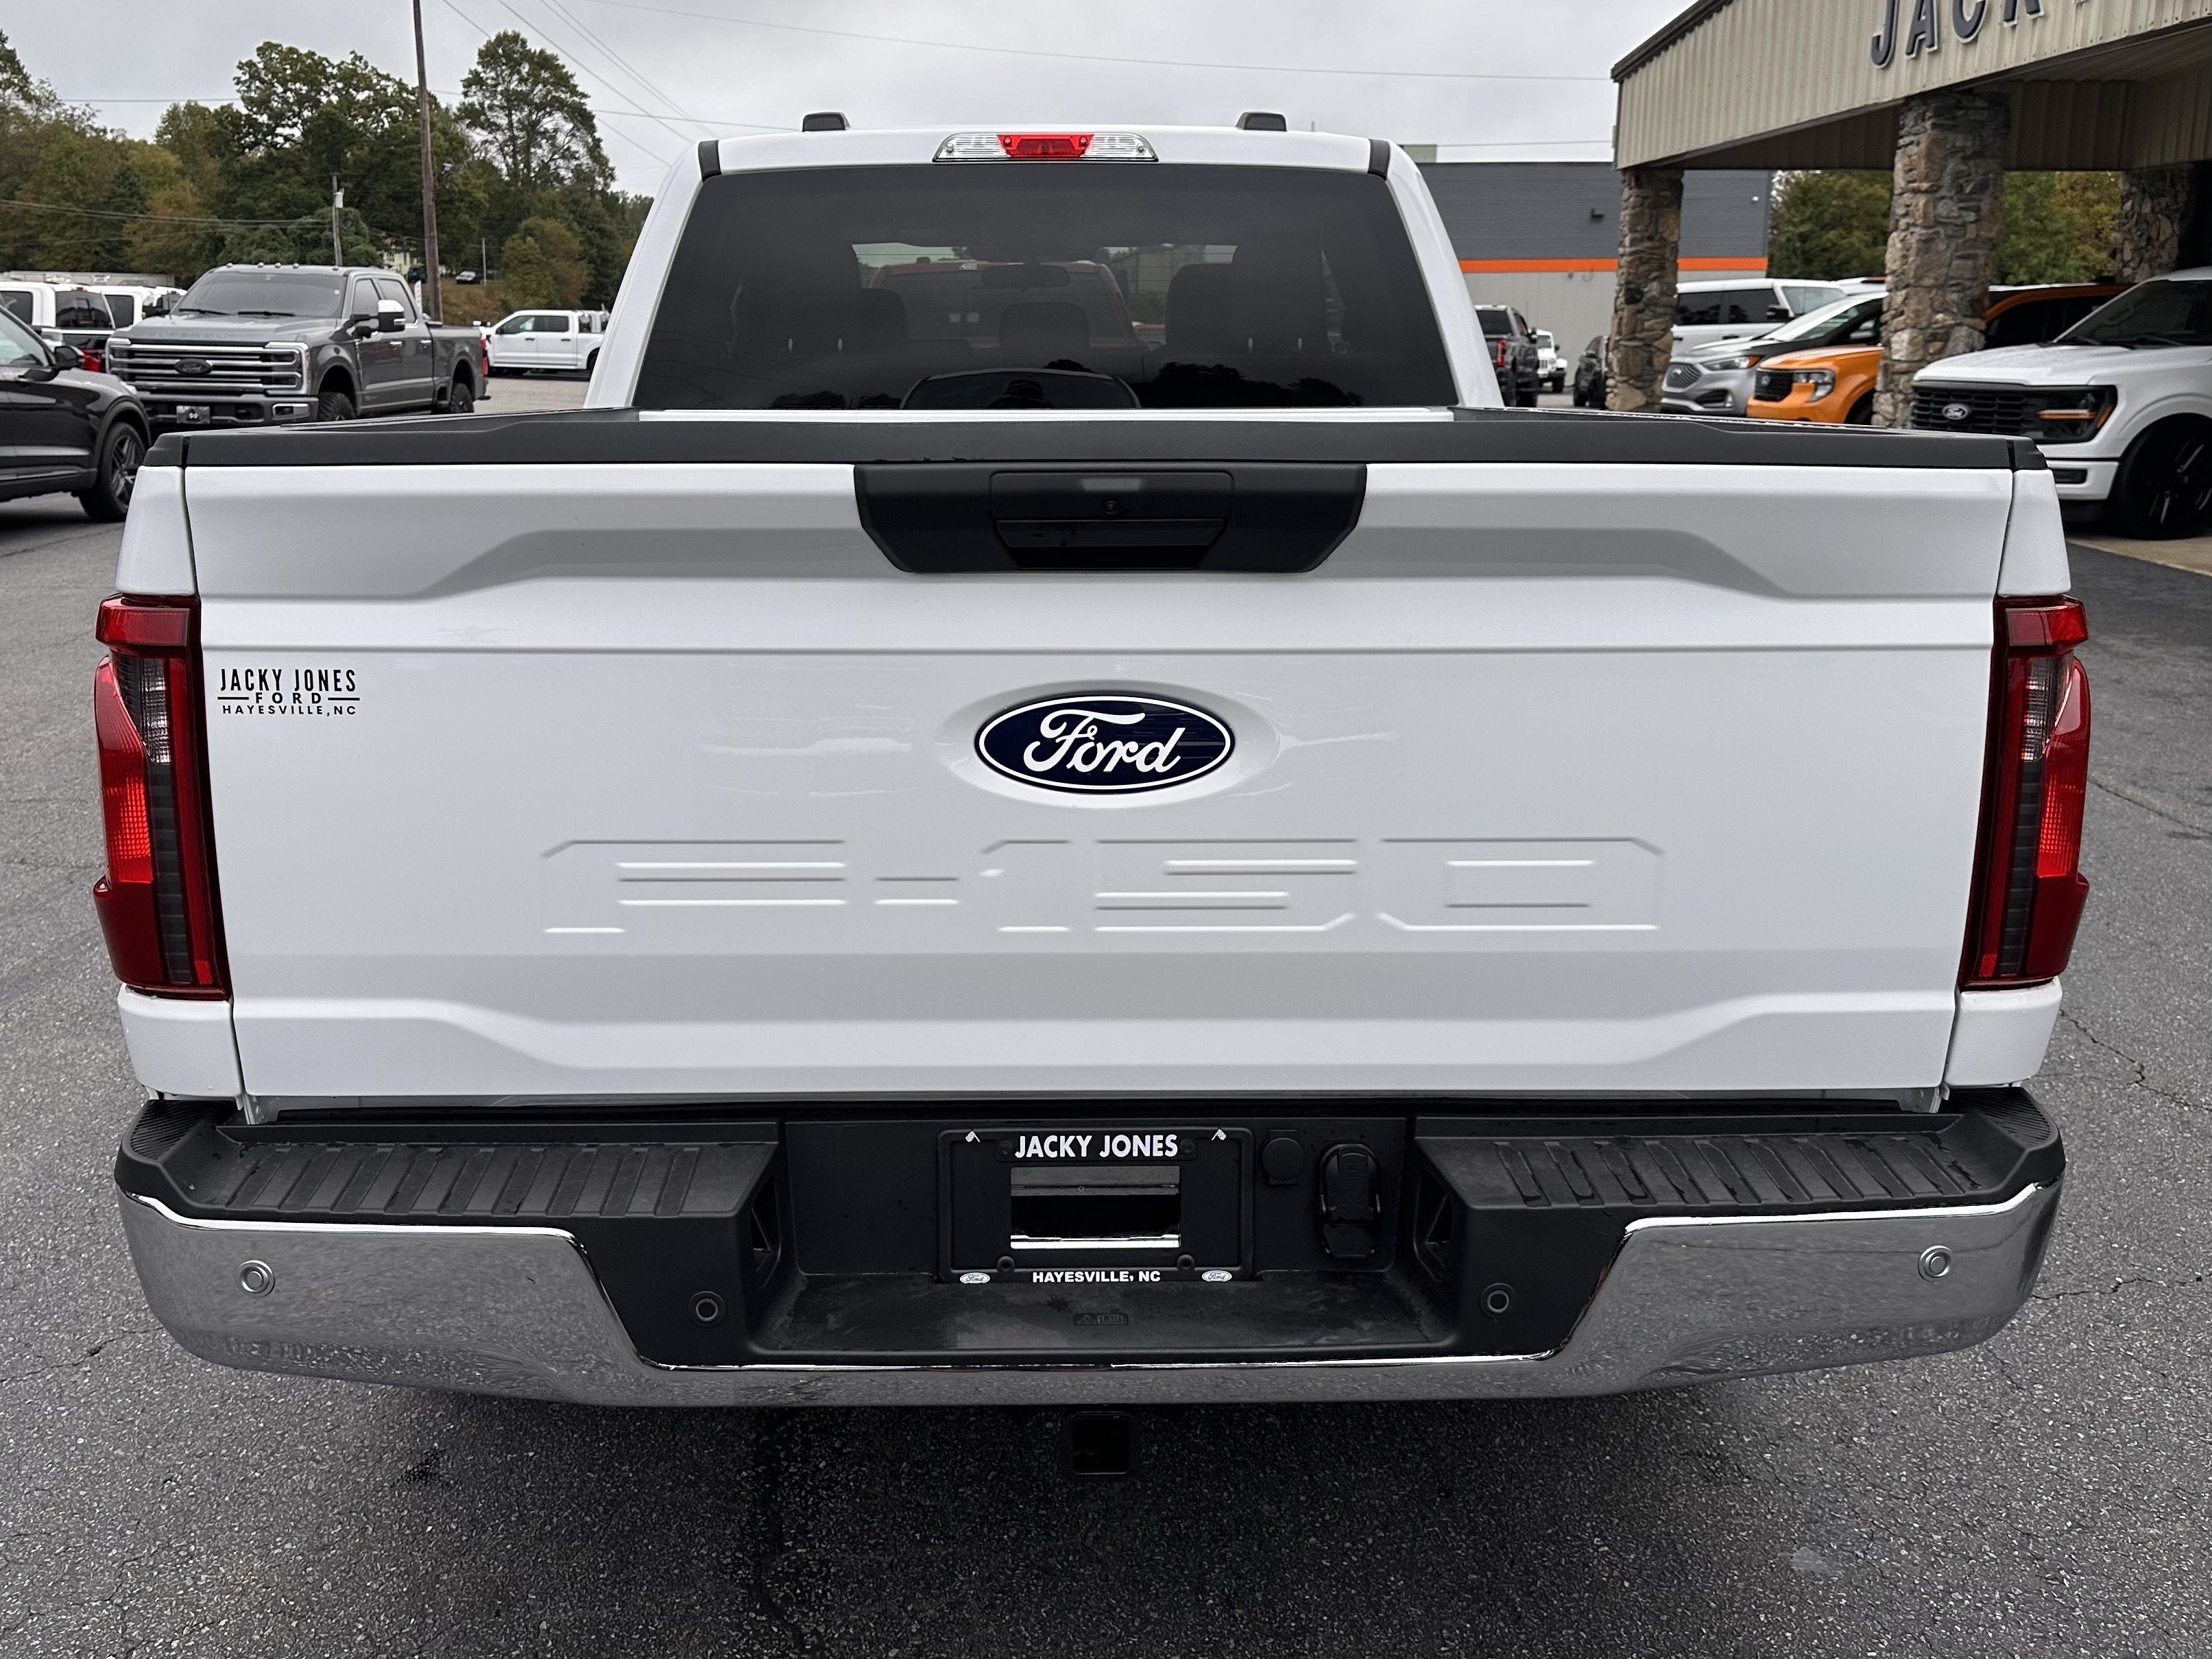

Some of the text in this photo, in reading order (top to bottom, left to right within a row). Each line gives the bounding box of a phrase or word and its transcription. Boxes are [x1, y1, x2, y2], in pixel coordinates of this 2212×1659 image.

[220, 668, 356, 692] JACKY JONES
[255, 692, 322, 704] FORD
[1023, 709, 1186, 773] Ford
[540, 837, 1665, 934] F-150
[1015, 1134, 1178, 1159] JACKY JONES
[1033, 1270, 1161, 1283] HAYESVILLE, NC
